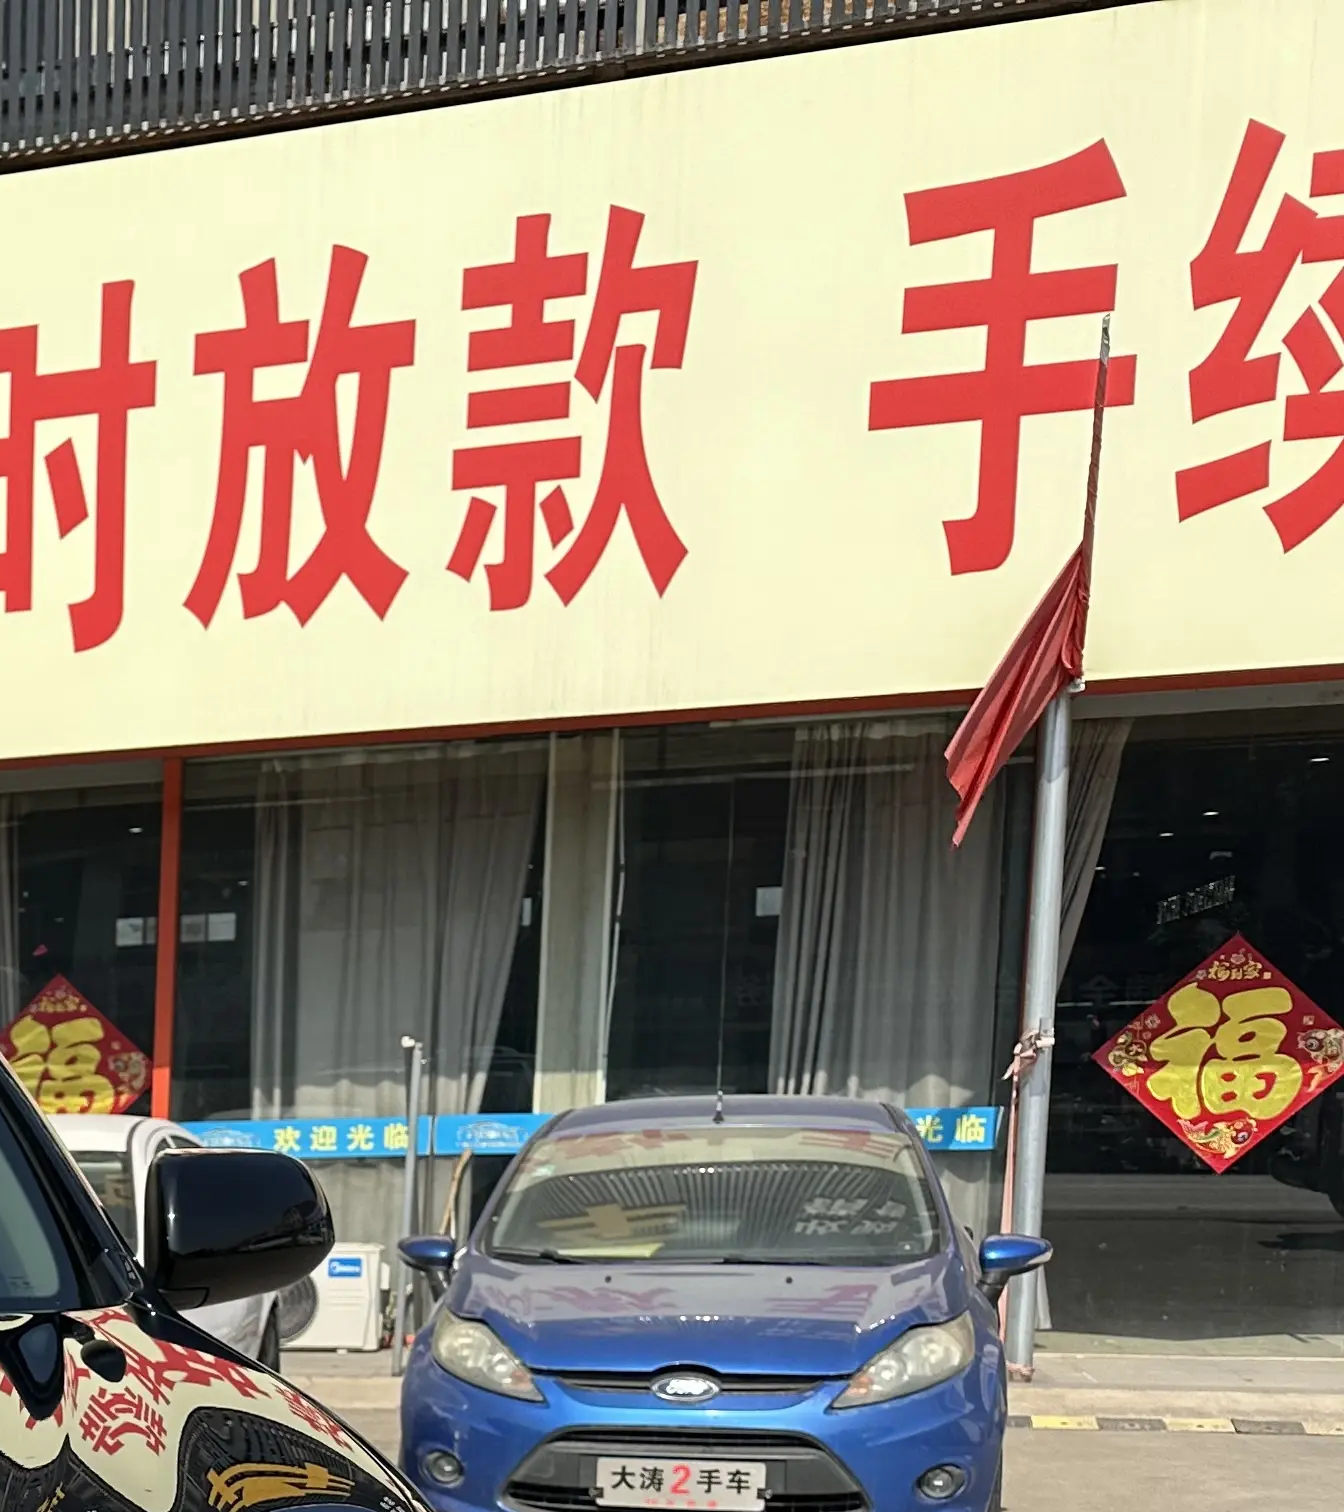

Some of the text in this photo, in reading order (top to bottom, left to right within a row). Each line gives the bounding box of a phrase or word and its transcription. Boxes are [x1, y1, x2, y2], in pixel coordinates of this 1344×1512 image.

[868, 118, 1344, 576] 手续
[9, 1015, 116, 1115] 福
[1146, 982, 1304, 1120] 福
[273, 1122, 410, 1152] 欢迎光临
[611, 1464, 751, 1495] 大涛2手车
